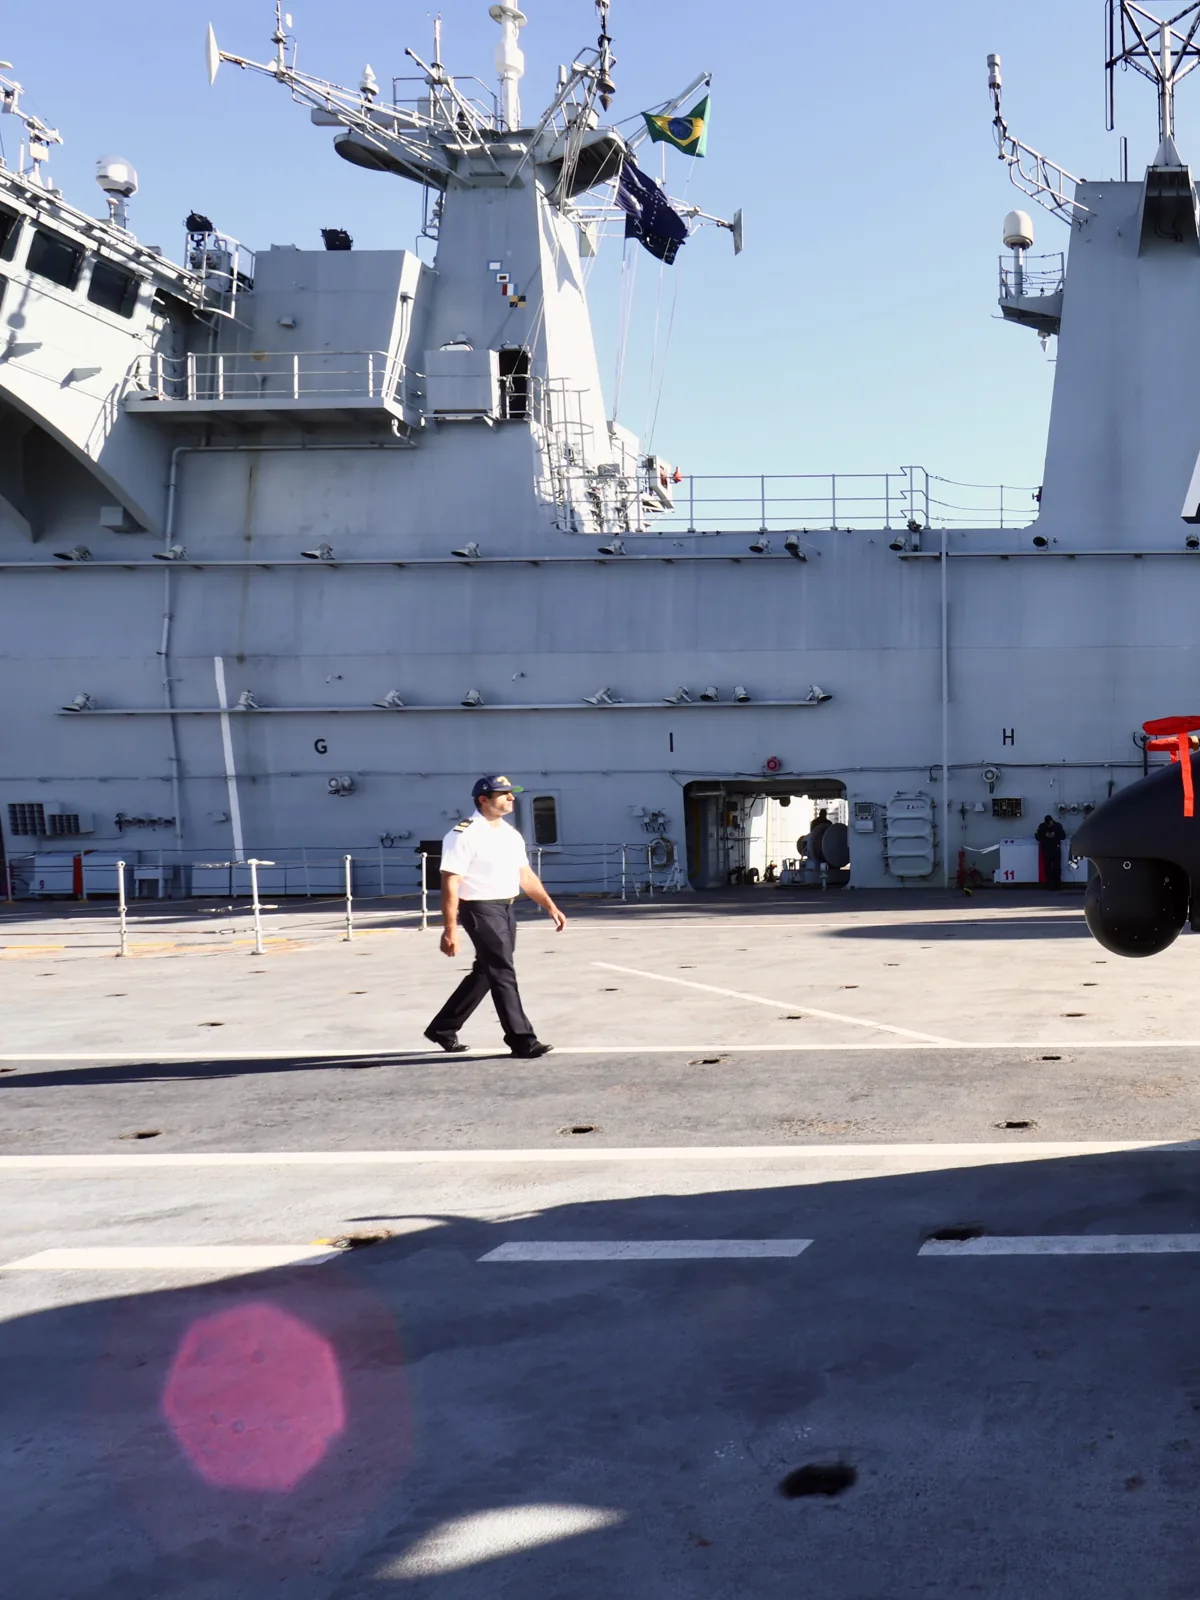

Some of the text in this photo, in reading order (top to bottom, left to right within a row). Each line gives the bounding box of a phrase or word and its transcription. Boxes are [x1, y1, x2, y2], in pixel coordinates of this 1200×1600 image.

[1003, 728, 1014, 746] H
[314, 738, 328, 755] G
[1004, 870, 1015, 880] 11
